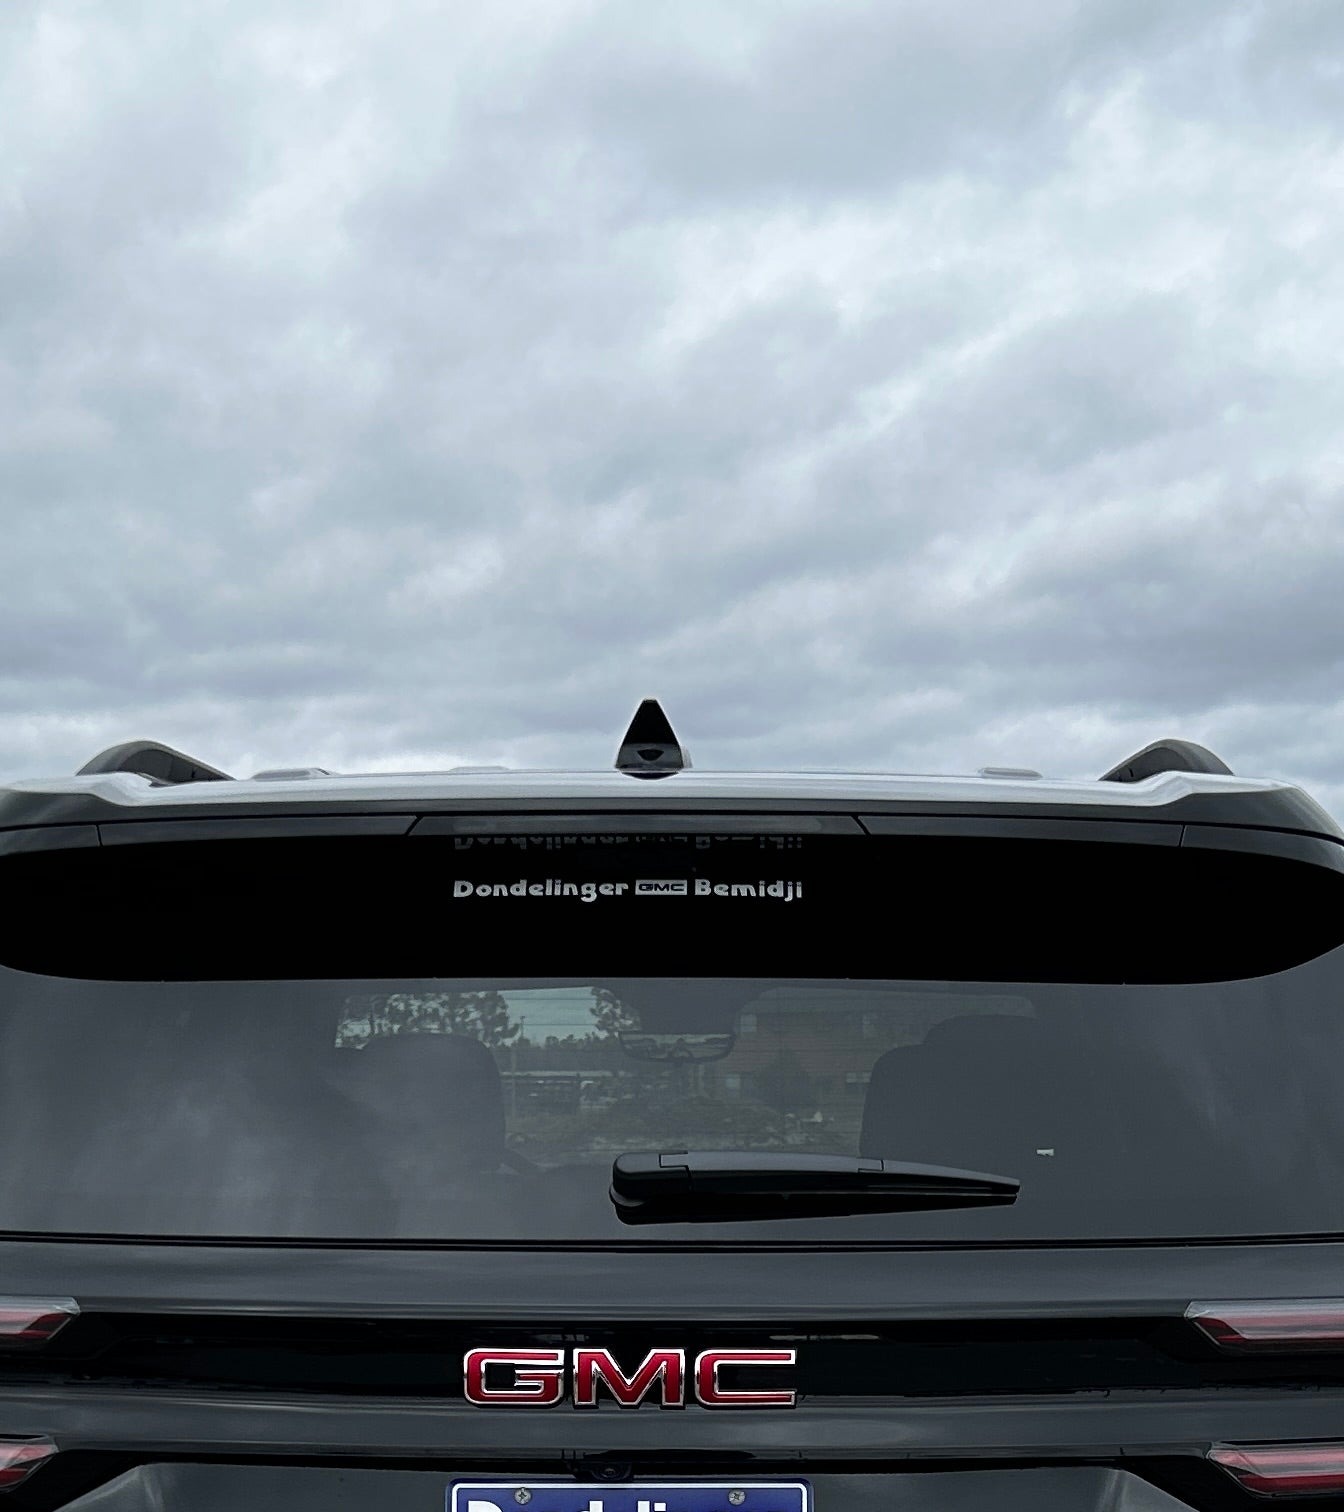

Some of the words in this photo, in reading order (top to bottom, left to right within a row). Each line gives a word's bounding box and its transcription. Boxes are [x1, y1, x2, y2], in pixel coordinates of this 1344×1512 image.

[453, 879, 629, 902] Dondelinger
[638, 881, 687, 894] GMC
[694, 879, 802, 902] Bemidji
[463, 1348, 797, 1405] GMC
